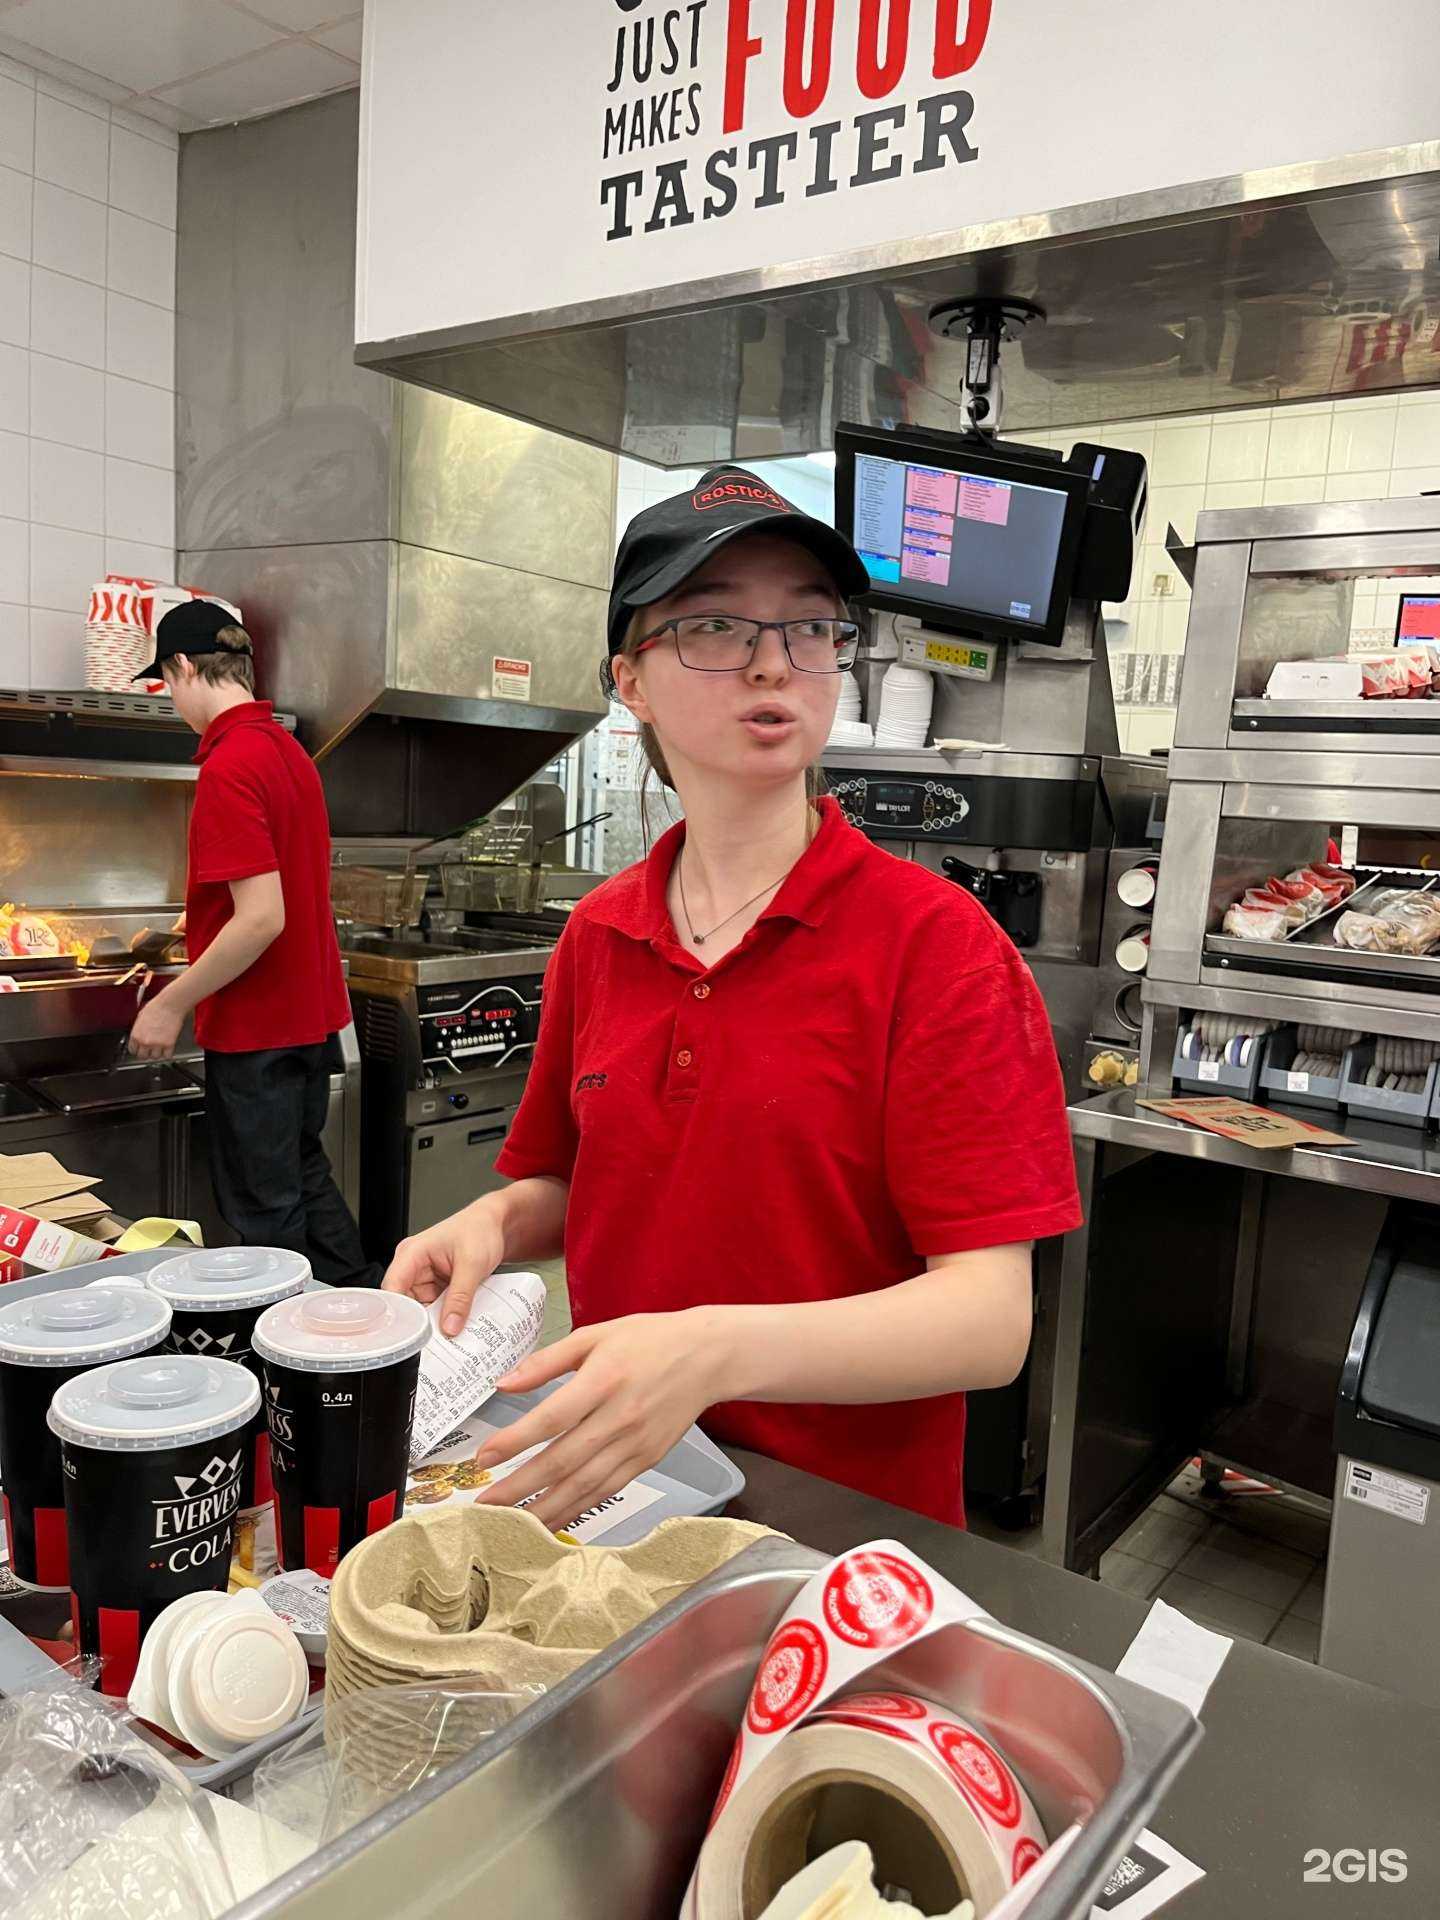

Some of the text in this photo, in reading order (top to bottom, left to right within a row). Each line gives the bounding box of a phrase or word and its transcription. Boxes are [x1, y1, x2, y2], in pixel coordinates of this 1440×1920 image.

[606, 1, 707, 92] JUST
[602, 82, 701, 159] MAKES
[600, 90, 979, 241] TASTIER
[321, 1392, 353, 1403] 0.4л
[155, 1473, 242, 1539] EVERVESS
[168, 1525, 232, 1573] COLA
